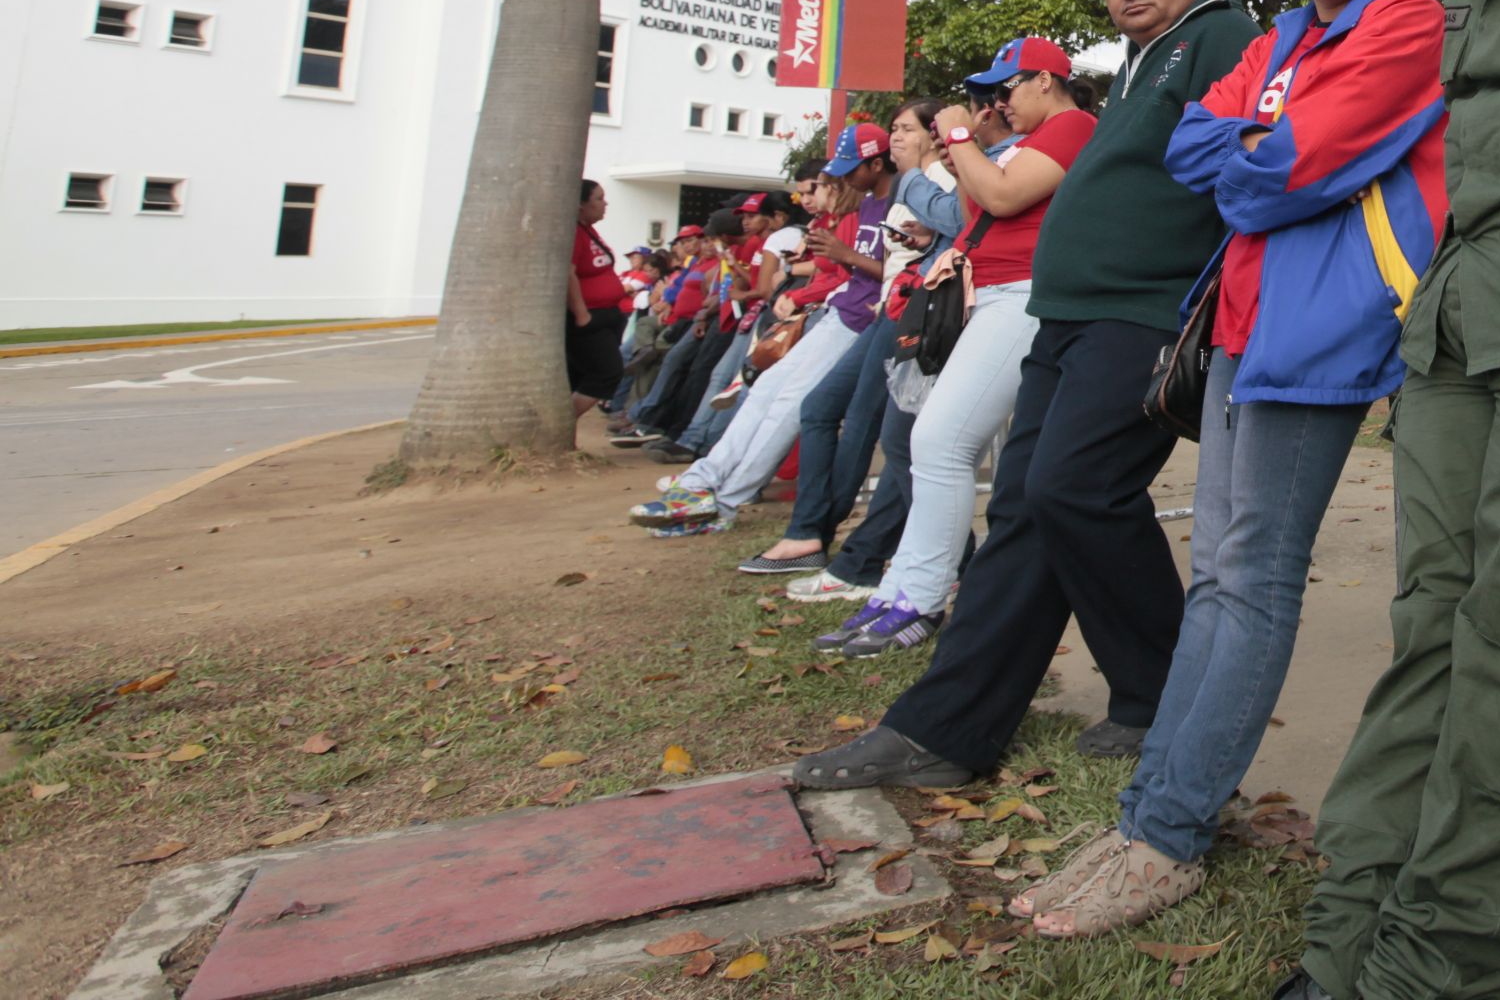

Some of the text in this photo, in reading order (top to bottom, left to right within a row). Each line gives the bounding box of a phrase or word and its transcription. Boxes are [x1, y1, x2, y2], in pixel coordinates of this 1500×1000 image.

[638, 16, 689, 34] ACADEMIA
[691, 25, 727, 41] MILITAR
[728, 32, 740, 44] DE
[740, 13, 757, 29] DE
